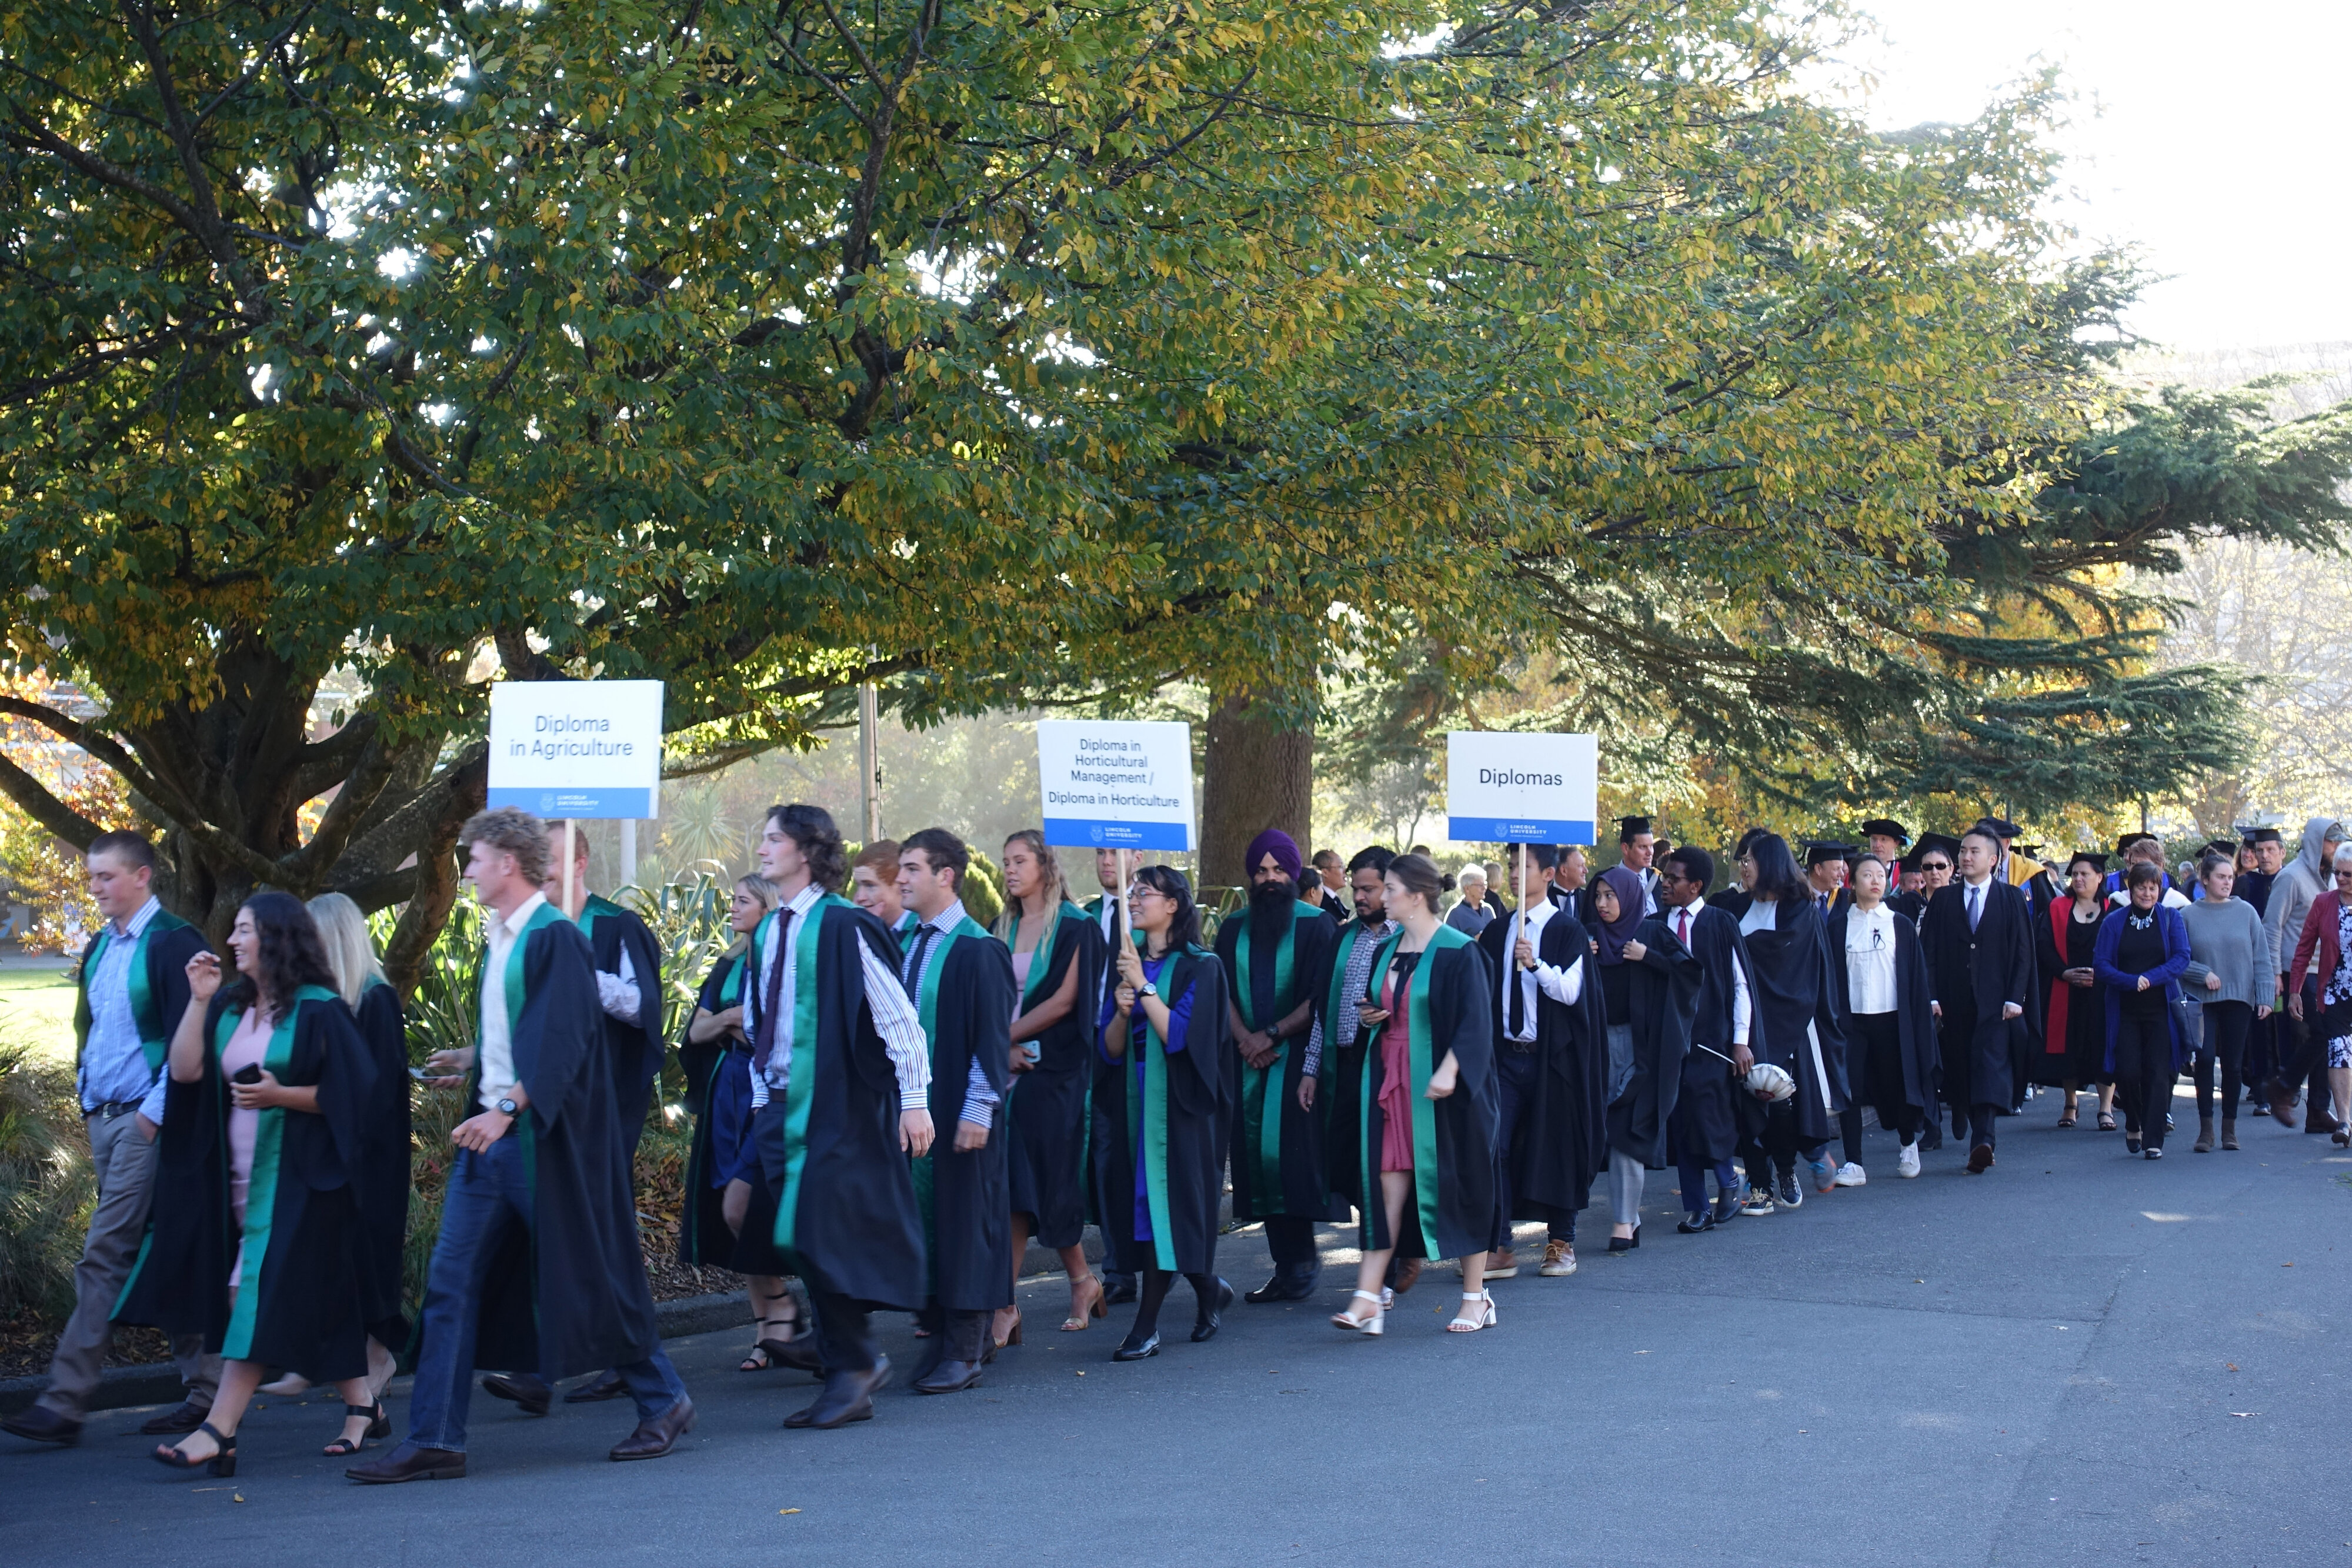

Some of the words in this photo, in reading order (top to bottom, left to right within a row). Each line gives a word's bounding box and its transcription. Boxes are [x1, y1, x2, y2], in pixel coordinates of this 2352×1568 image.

[535, 714, 610, 735] Diploma
[510, 739, 526, 756] in
[531, 738, 634, 760] Agriculture
[1080, 739, 1127, 752] Diploma
[1130, 740, 1141, 751] in
[1075, 754, 1148, 768] Horticultural
[1071, 770, 1146, 785] Management
[1480, 768, 1563, 788] Diplomas
[1049, 791, 1095, 806] Diploma
[1098, 793, 1109, 805] in
[1111, 793, 1180, 808] Horticulture
